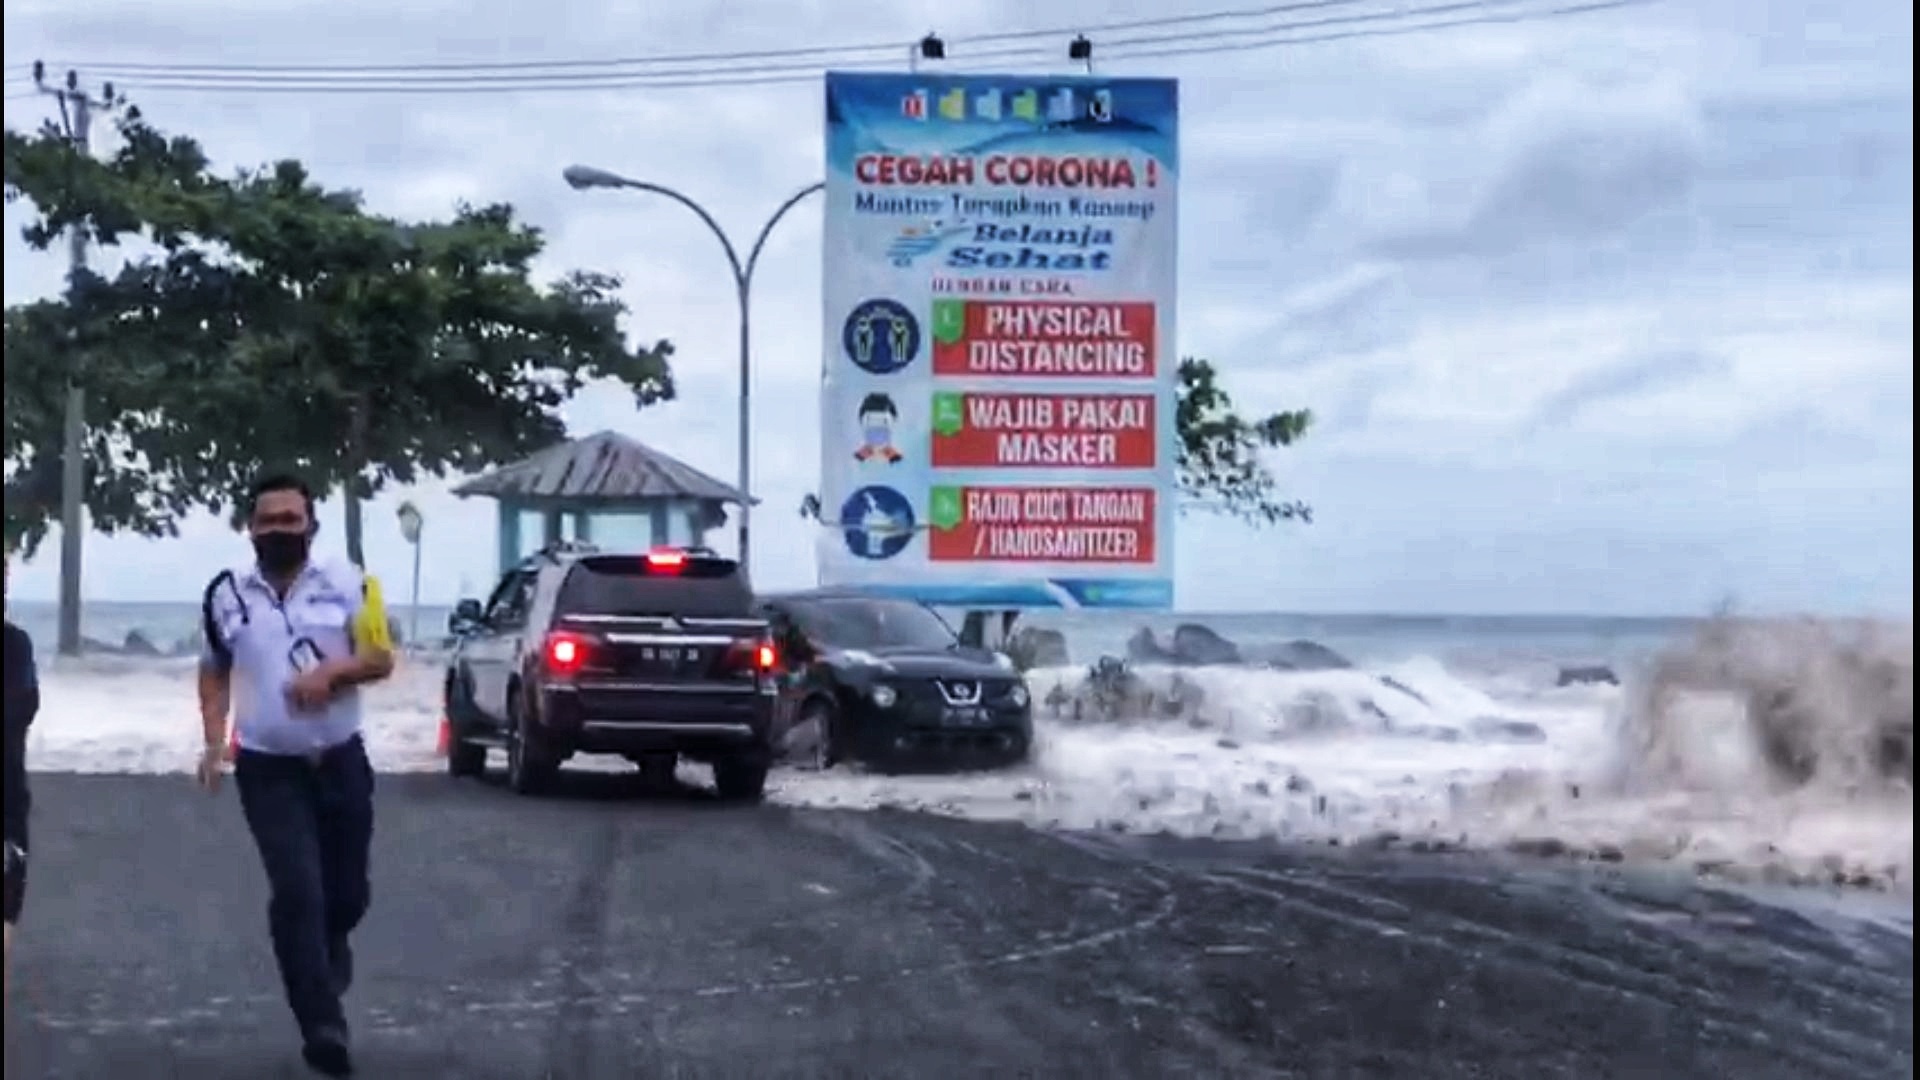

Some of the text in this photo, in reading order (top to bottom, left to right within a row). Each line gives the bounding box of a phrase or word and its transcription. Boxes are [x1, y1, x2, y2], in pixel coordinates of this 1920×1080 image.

[856, 155, 1157, 188] CEGAH CORONA !
[974, 223, 1113, 247] Belanja
[947, 248, 1110, 270] Sehat
[986, 306, 1131, 336] PHYSICAL
[969, 341, 1145, 371] DISTANCING
[968, 398, 1053, 429] WAJIB
[1062, 399, 1146, 429] PAKAI
[998, 434, 1116, 464] MASKER
[967, 492, 1020, 522] RAJIN
[1024, 491, 1067, 521] CUCI
[1072, 492, 1144, 523] TANGAN
